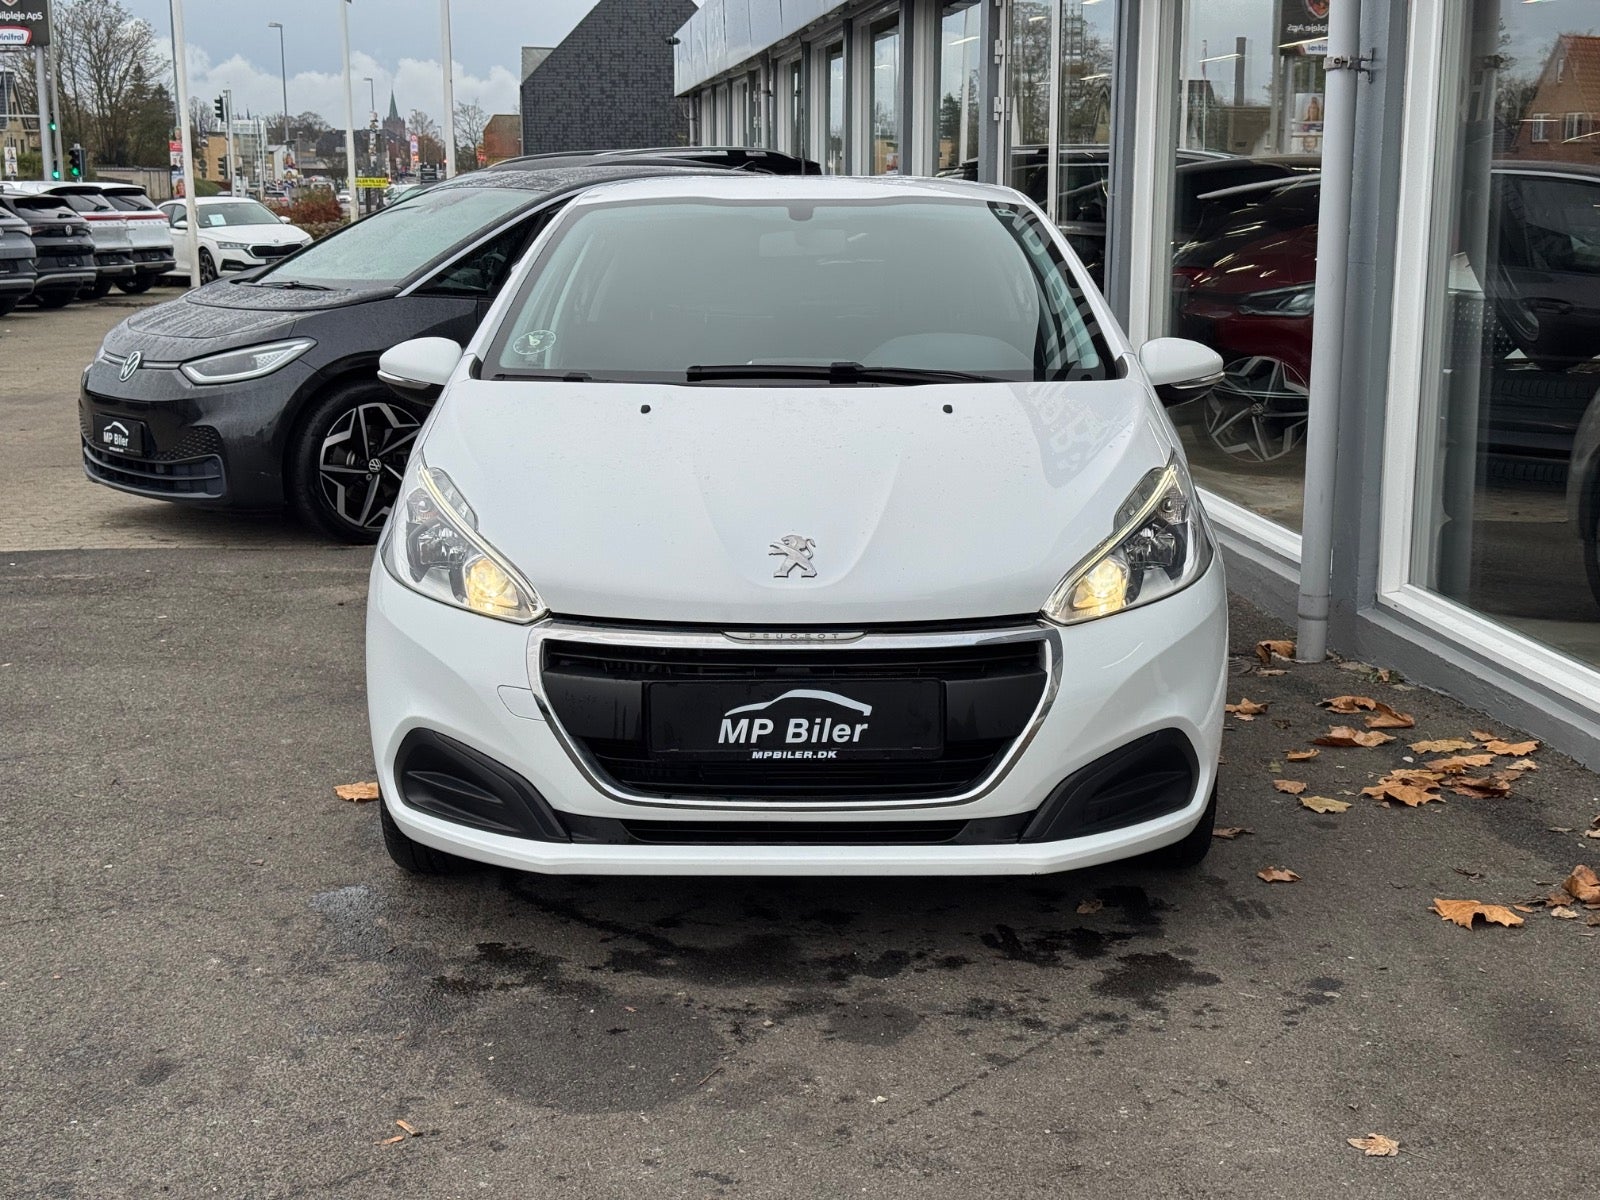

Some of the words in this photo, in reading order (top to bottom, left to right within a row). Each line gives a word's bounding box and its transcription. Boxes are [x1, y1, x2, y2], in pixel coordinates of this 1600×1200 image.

[0, 11, 25, 21] ilpleje
[26, 11, 43, 21] ApS
[103, 431, 113, 443] MP
[113, 433, 129, 447] Biler
[749, 632, 839, 640] PEUGEOT
[718, 718, 774, 744] MP
[785, 717, 869, 744] Biler
[751, 751, 838, 759] MPBILER.DK
